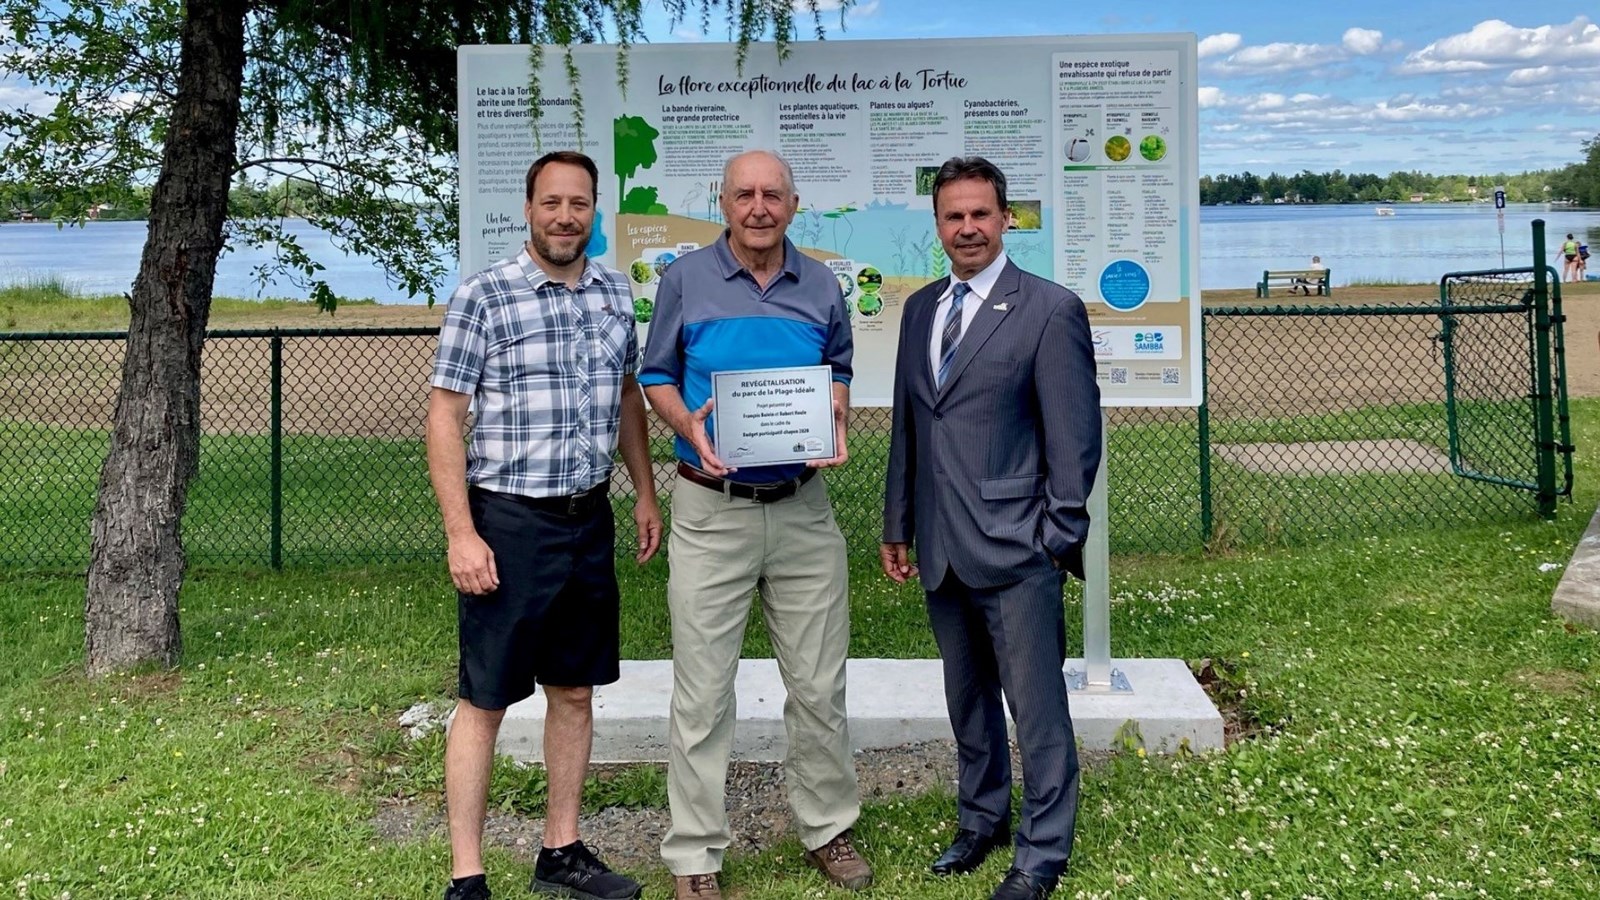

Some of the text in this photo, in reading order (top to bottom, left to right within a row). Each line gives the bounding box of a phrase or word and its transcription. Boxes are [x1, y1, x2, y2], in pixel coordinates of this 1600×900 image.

[1060, 60, 1130, 70] Une espèce exotique
[1060, 68, 1172, 78] envahissante qui refuse de partir
[658, 68, 968, 100] La flore exceptionnelle du lac à la Tortue
[476, 86, 541, 96] Le lac à la Torte
[477, 98, 500, 107] abrite
[793, 102, 818, 112] plantes
[820, 102, 860, 112] aquatiques,
[907, 100, 934, 110] algues?
[964, 99, 1020, 109] Cyanobactéries,
[487, 109, 502, 118] très
[672, 104, 693, 112] bande
[694, 104, 727, 113] riveraine,
[964, 109, 999, 118] présentes
[1011, 108, 1028, 117] non?
[677, 114, 700, 124] grande
[701, 113, 740, 123] protectrice
[779, 111, 846, 121] essentielles à la vie
[779, 122, 814, 132] aquatique
